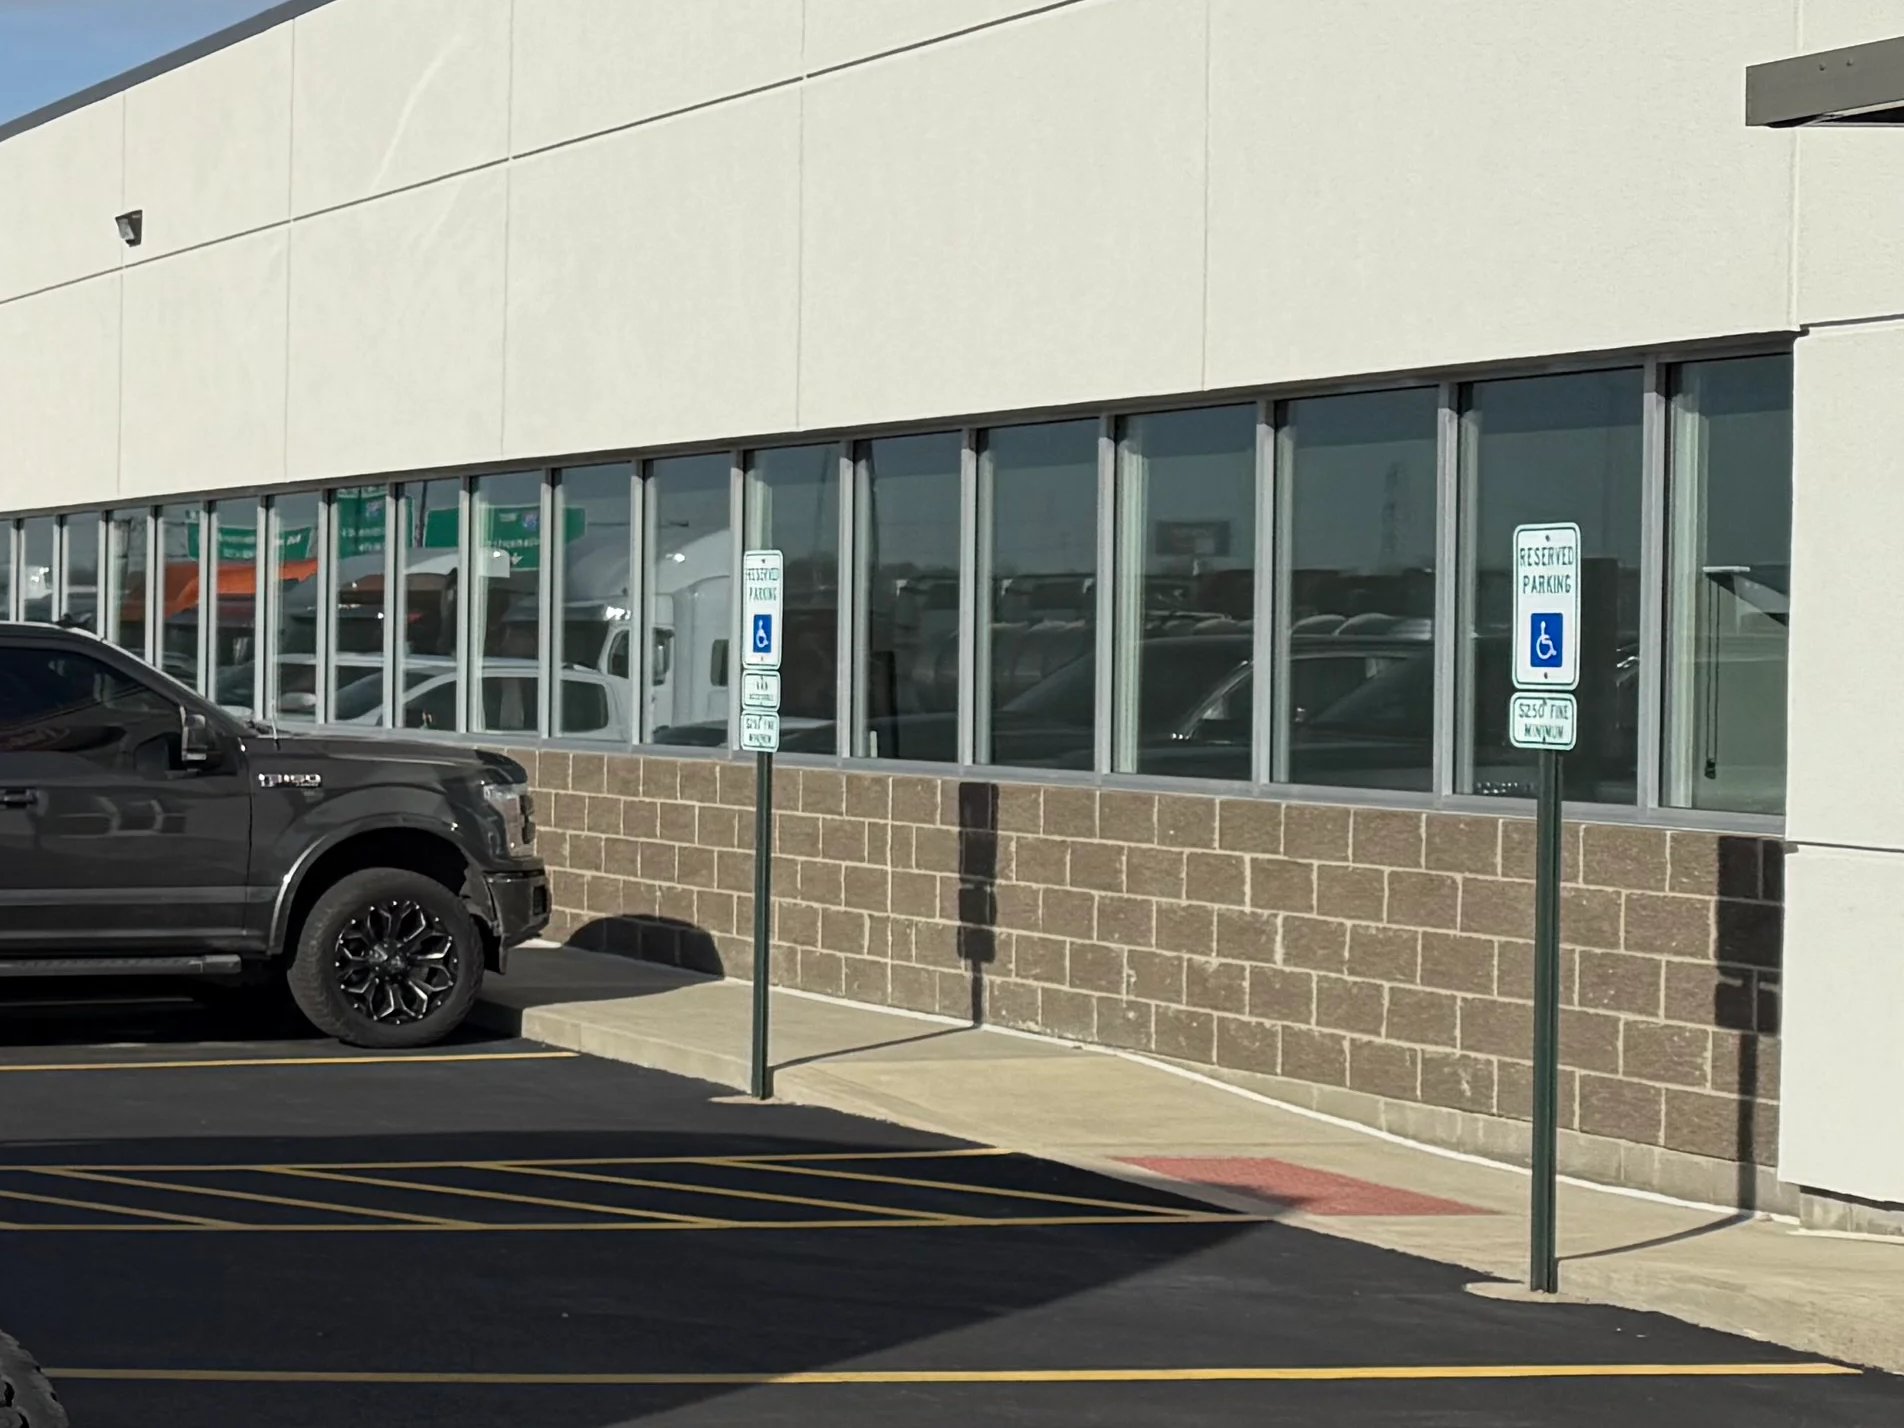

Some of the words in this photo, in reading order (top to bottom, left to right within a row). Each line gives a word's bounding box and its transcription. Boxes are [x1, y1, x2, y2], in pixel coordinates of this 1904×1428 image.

[1519, 545, 1575, 567] RESERVED
[1522, 574, 1572, 594] PARKING
[1518, 702, 1546, 719] $250
[1550, 703, 1569, 721] FINE
